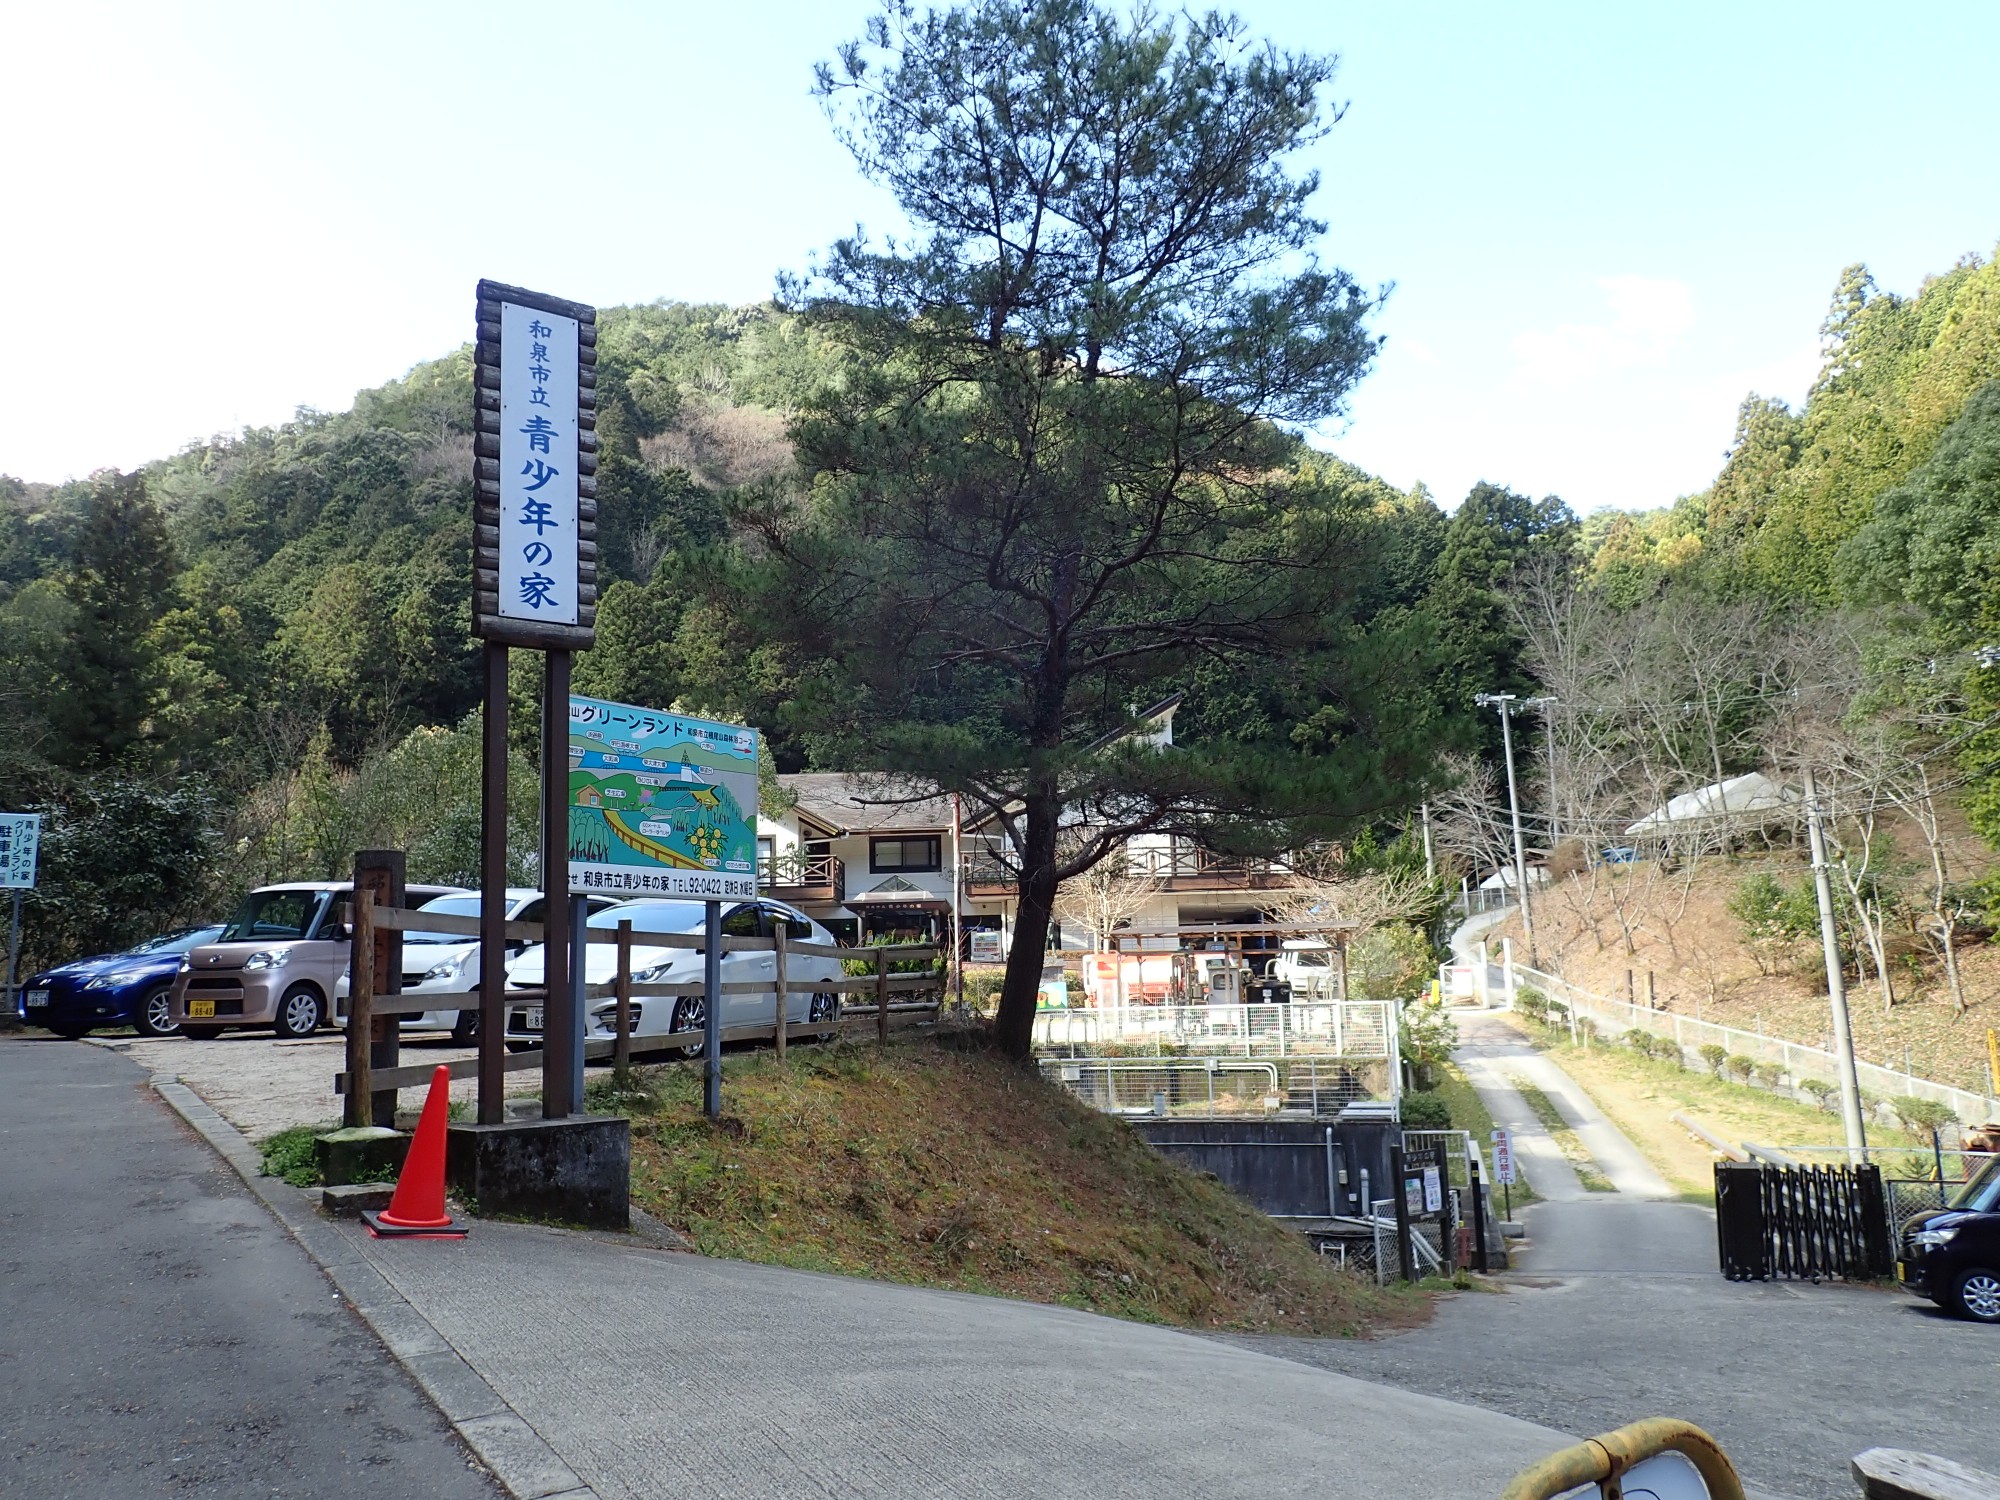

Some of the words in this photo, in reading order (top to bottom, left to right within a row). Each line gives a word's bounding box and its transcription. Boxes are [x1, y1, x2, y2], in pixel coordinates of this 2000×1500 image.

[519, 320, 560, 609] 和泉市立青少年の家
[568, 705, 684, 738] 山グリーンランド
[11, 819, 25, 881] グリーンランド
[21, 820, 34, 881] 青少年の家
[584, 870, 670, 891] 和泉市立青少年の家
[1496, 1131, 1511, 1181] 車両通行禁止
